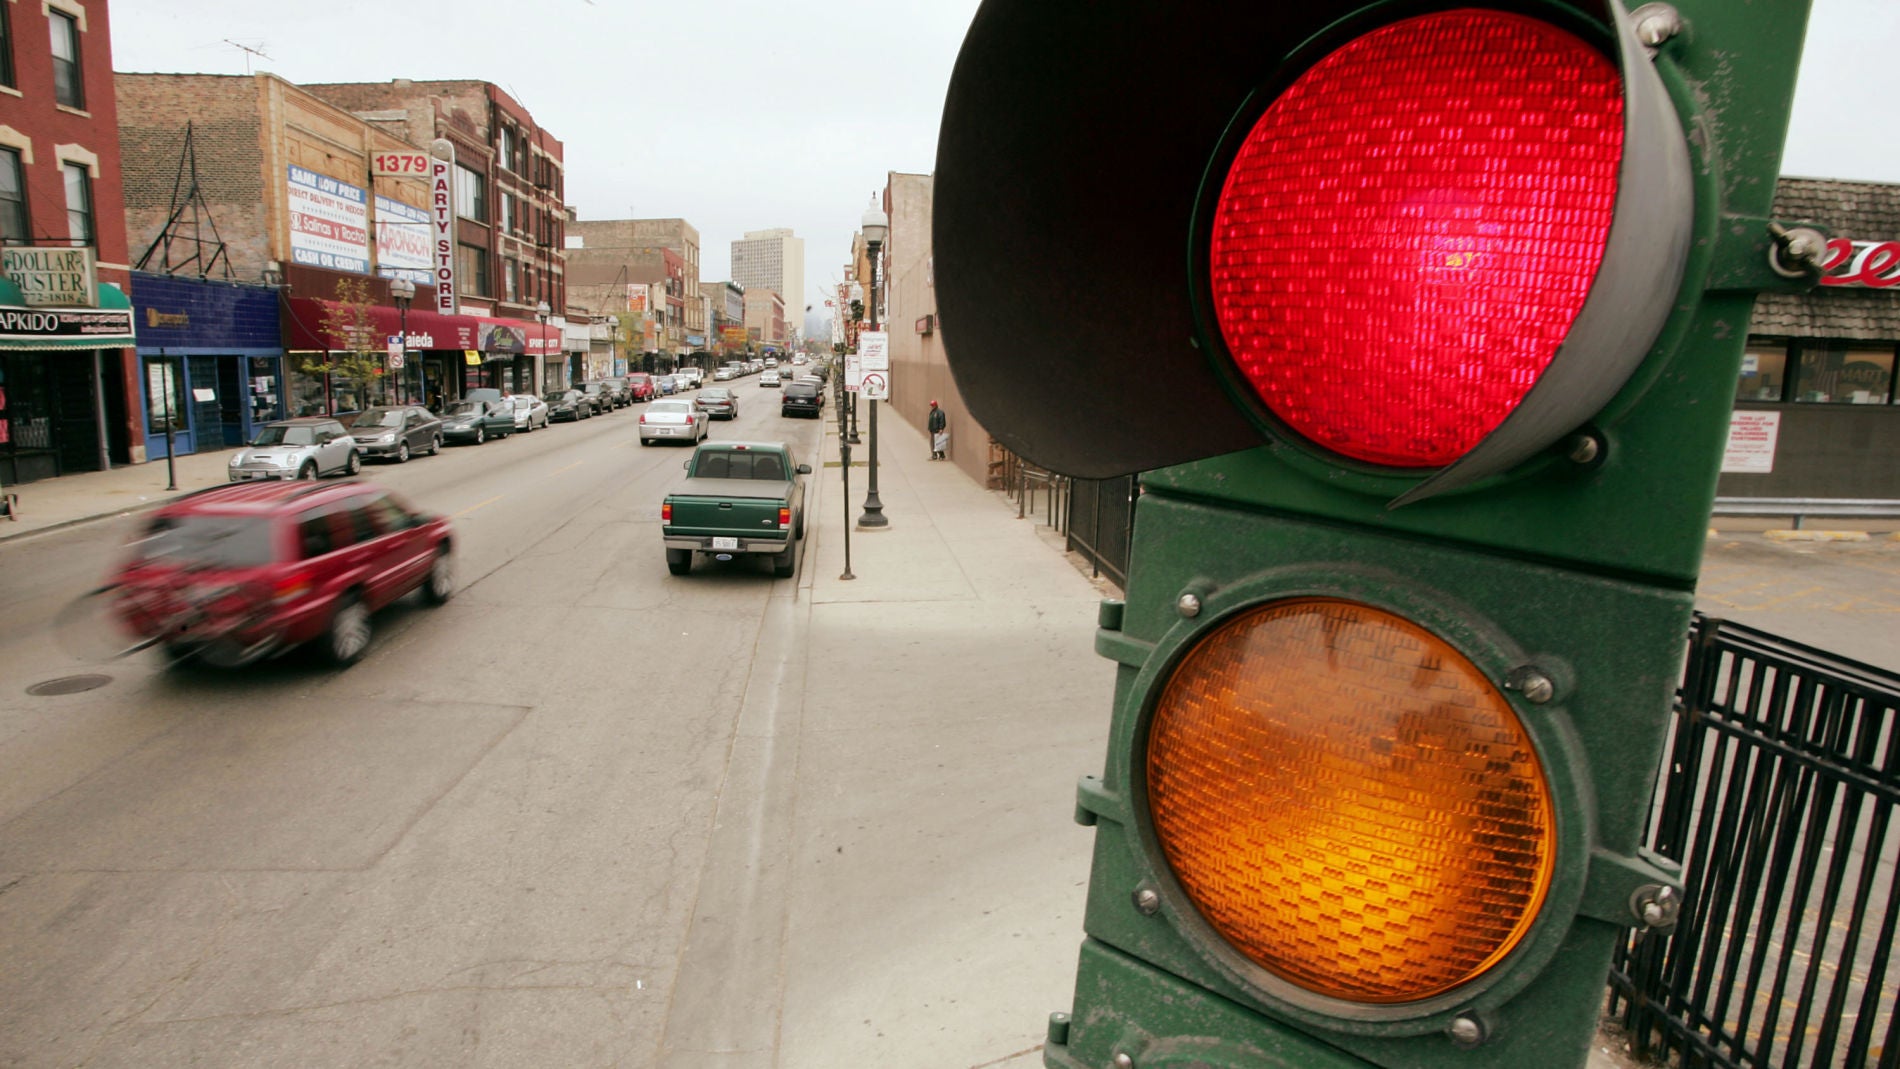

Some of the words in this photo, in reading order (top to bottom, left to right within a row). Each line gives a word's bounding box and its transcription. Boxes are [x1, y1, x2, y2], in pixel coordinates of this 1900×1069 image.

[375, 155, 427, 172] 1379
[291, 166, 317, 187] SAME
[318, 175, 338, 194] LOW
[338, 182, 361, 202] PRICE
[288, 186, 308, 199] DIRECT
[336, 200, 344, 211] TO
[433, 164, 448, 234] PARTY
[303, 216, 332, 236] Salinas
[341, 226, 365, 244] Rocha
[11, 252, 76, 271] DOLLAR
[295, 248, 320, 265] CASH
[320, 253, 334, 267] OR
[10, 272, 82, 292] BUSTER
[437, 239, 452, 308] STORE
